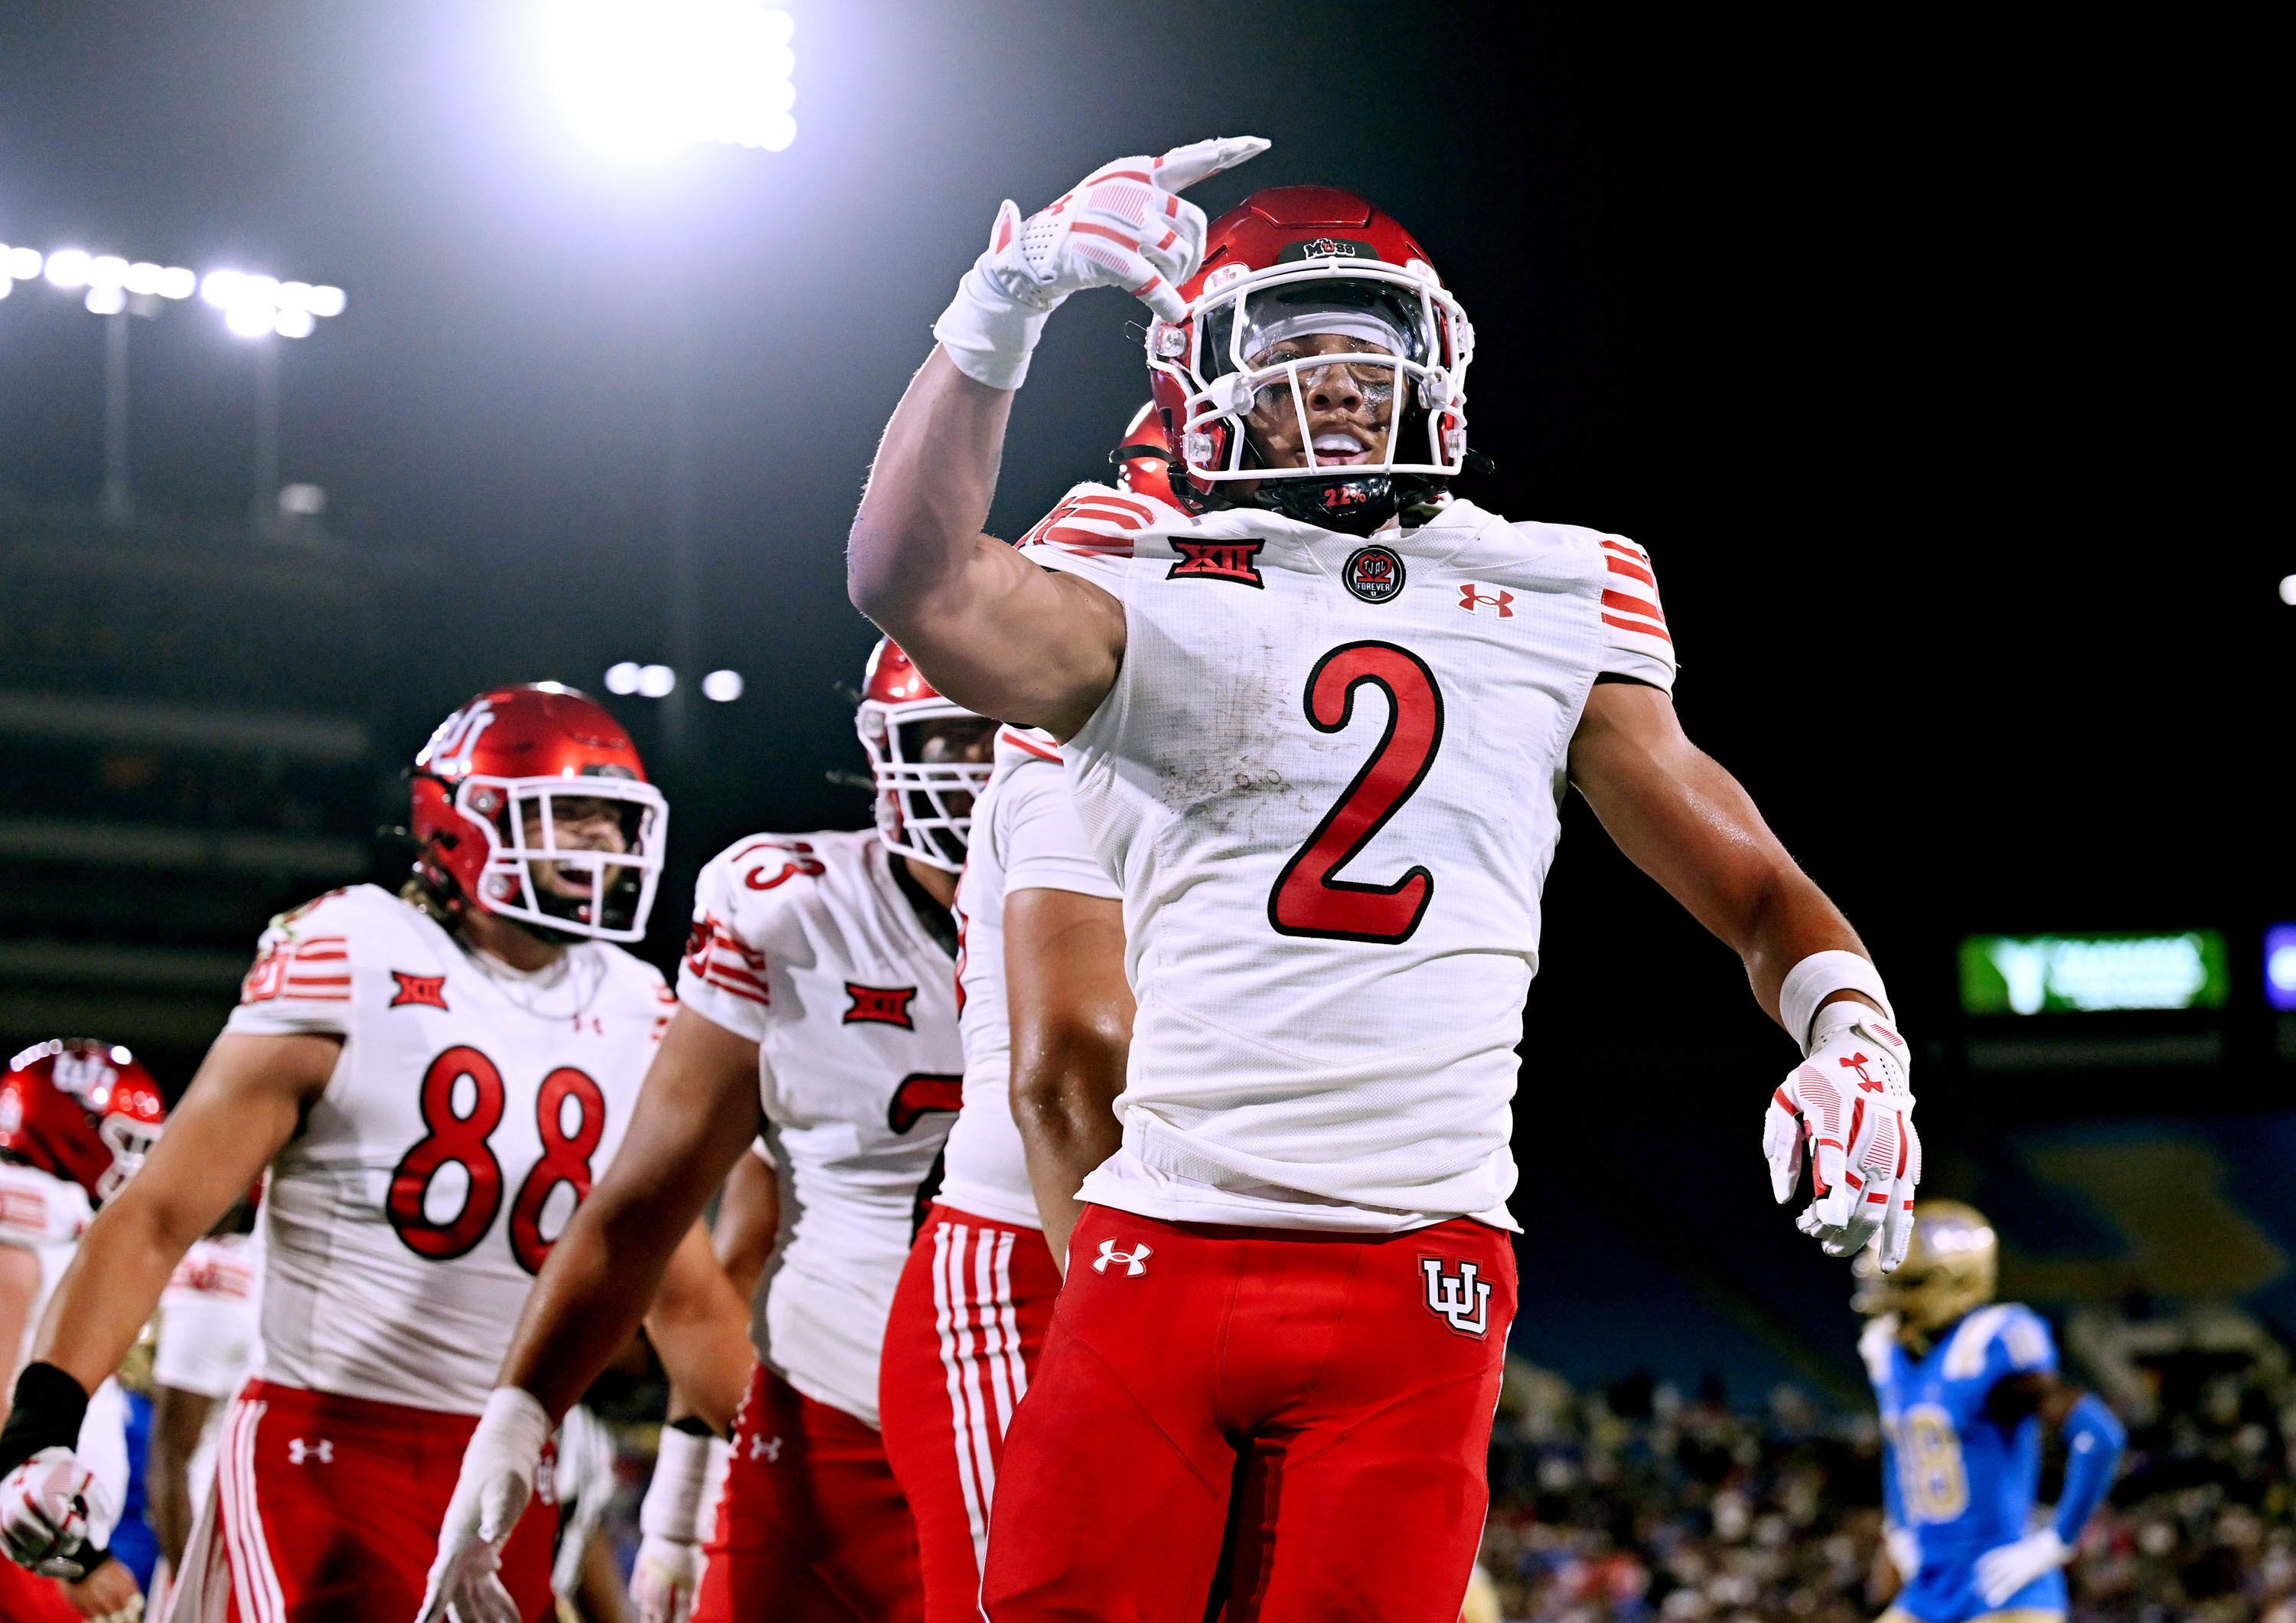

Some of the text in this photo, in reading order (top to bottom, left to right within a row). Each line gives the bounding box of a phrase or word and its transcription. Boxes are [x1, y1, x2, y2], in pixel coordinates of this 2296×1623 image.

[1166, 537, 1265, 589] XII
[1357, 583, 1390, 591] FOREVER
[1267, 639, 1444, 945] 2
[386, 1044, 605, 1276] 88
